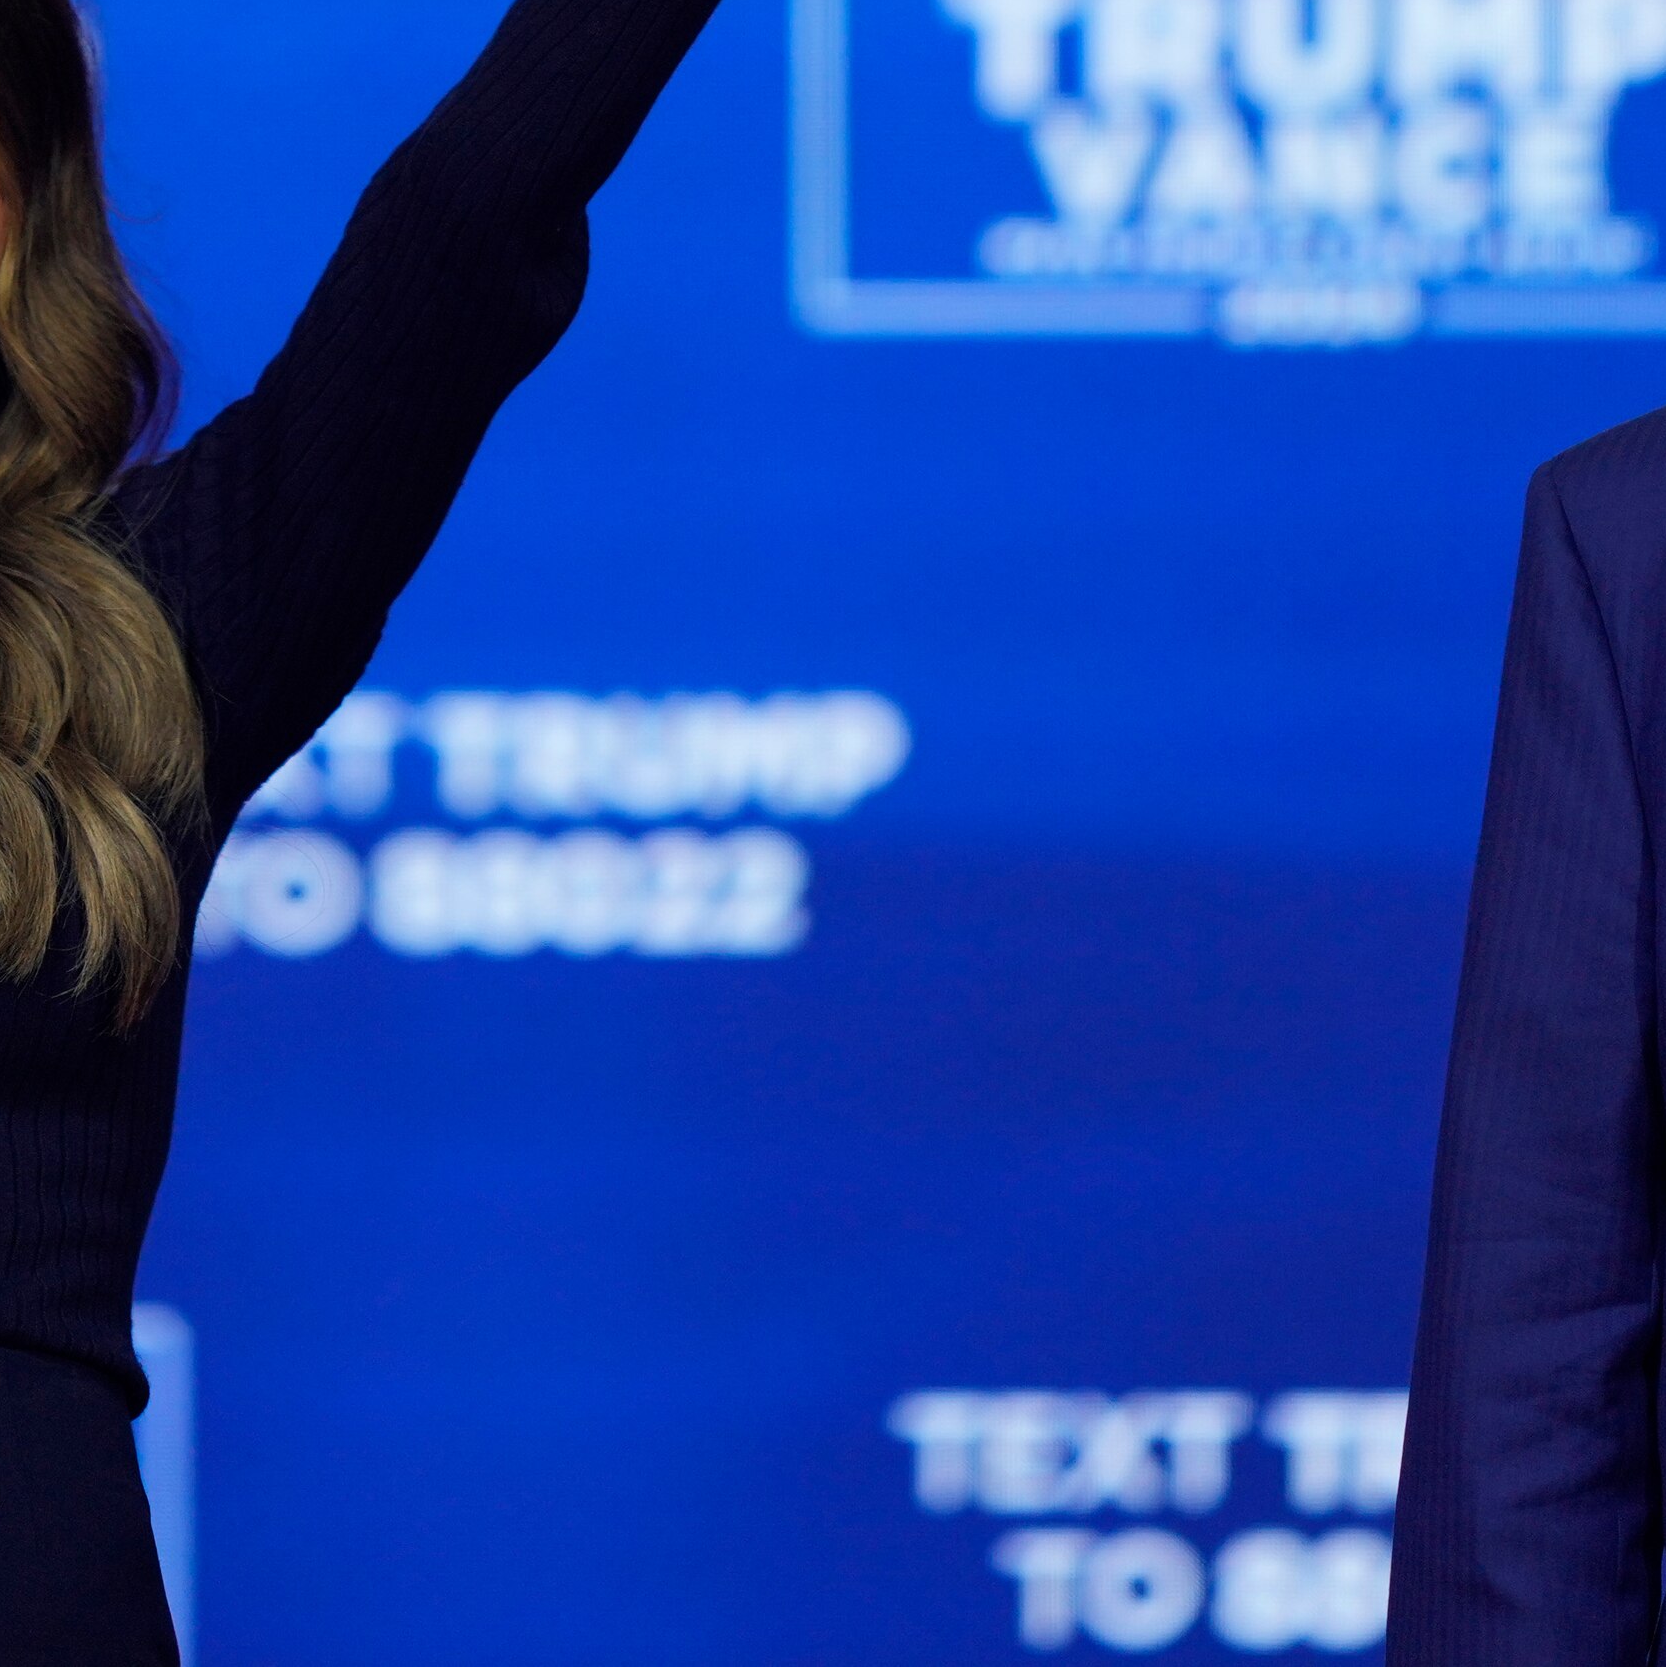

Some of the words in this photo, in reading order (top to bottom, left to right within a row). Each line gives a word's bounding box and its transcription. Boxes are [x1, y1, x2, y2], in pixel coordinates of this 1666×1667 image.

[1031, 101, 1611, 229] VANCE
[425, 690, 910, 818] TRUMP
[887, 1388, 1254, 1515] TEXT
[987, 1528, 1205, 1654] TO
